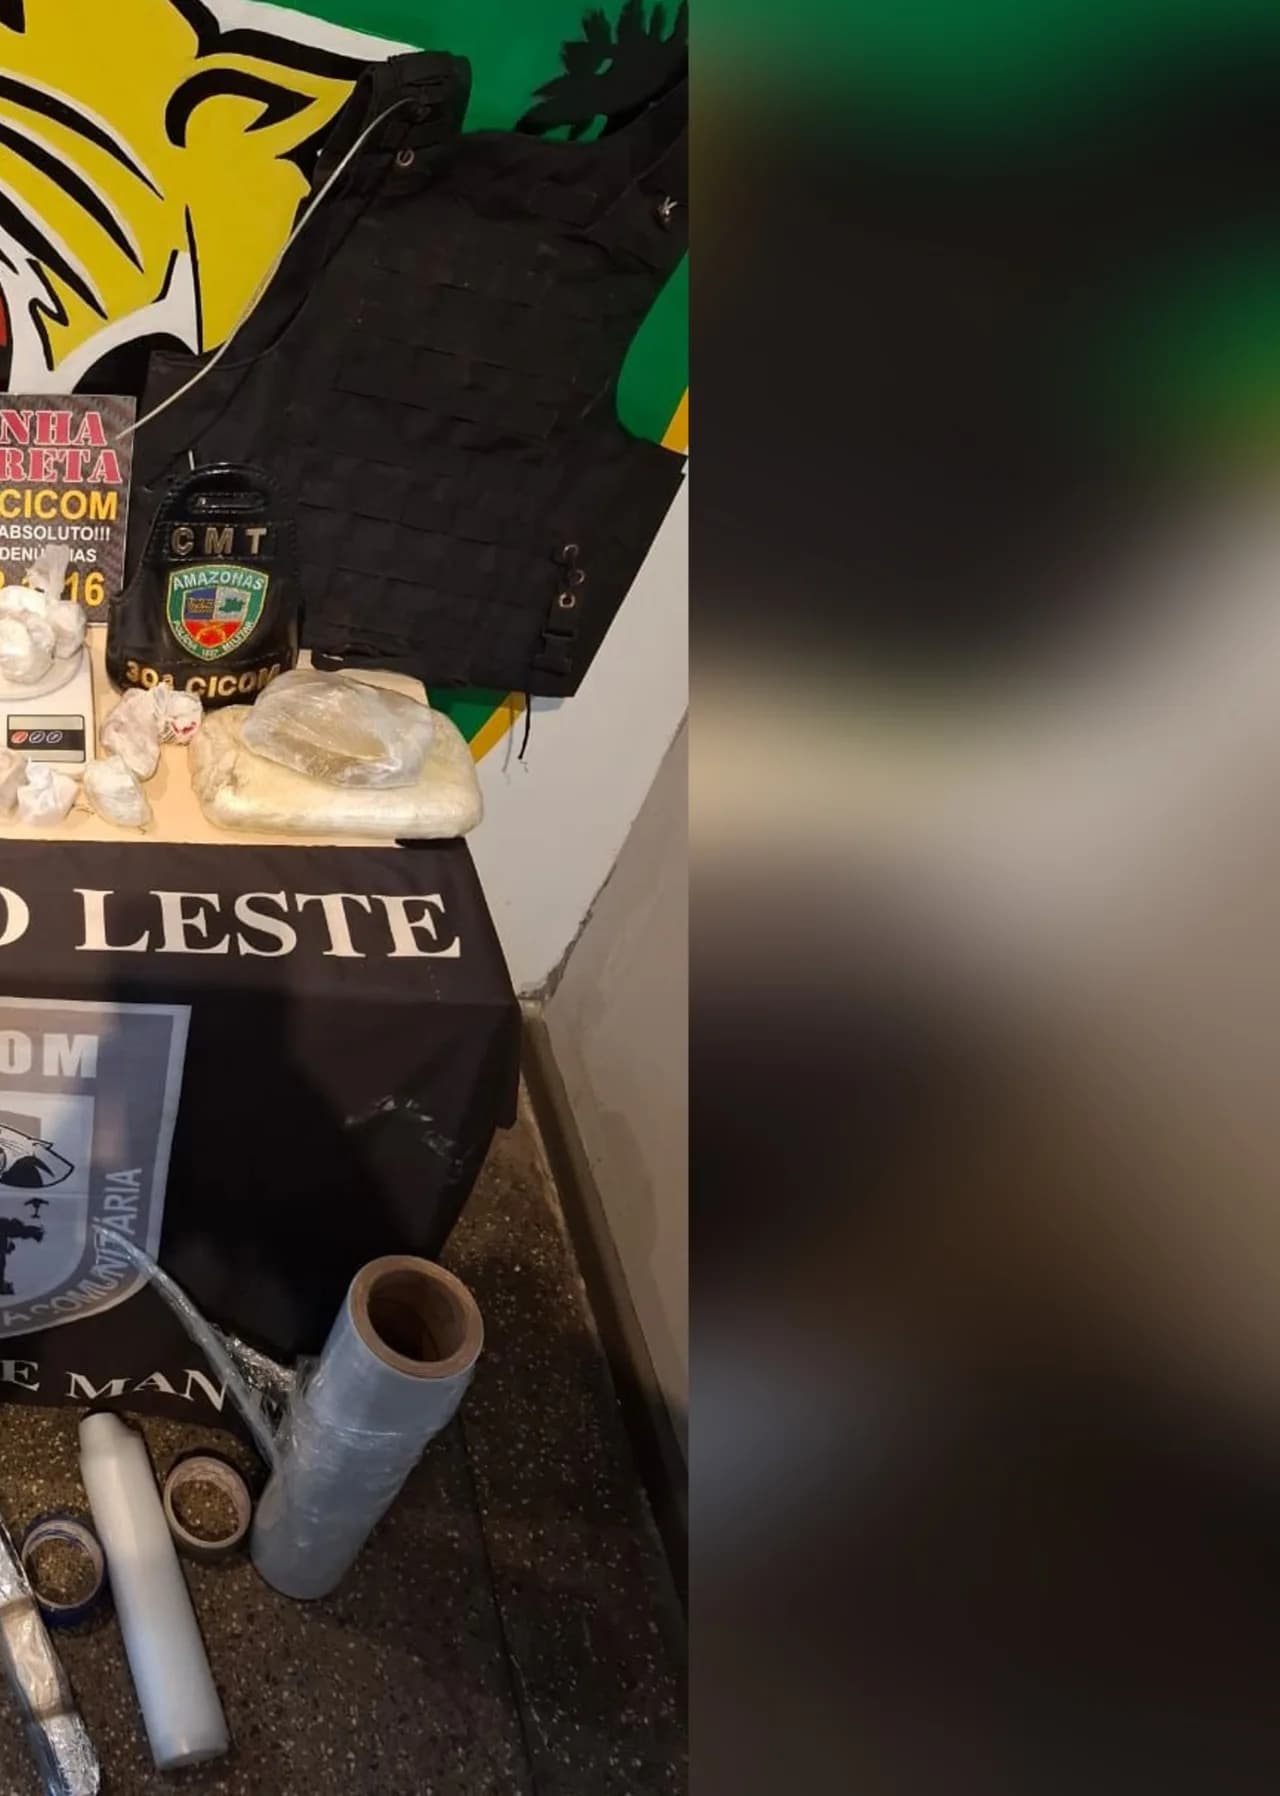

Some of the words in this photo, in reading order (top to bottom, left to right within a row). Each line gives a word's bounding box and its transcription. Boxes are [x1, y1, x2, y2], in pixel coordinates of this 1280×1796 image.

[171, 527, 267, 556] CMT
[173, 571, 265, 591] AMAZONAS
[73, 888, 461, 958] LESTE
[1, 1359, 41, 1392] E
